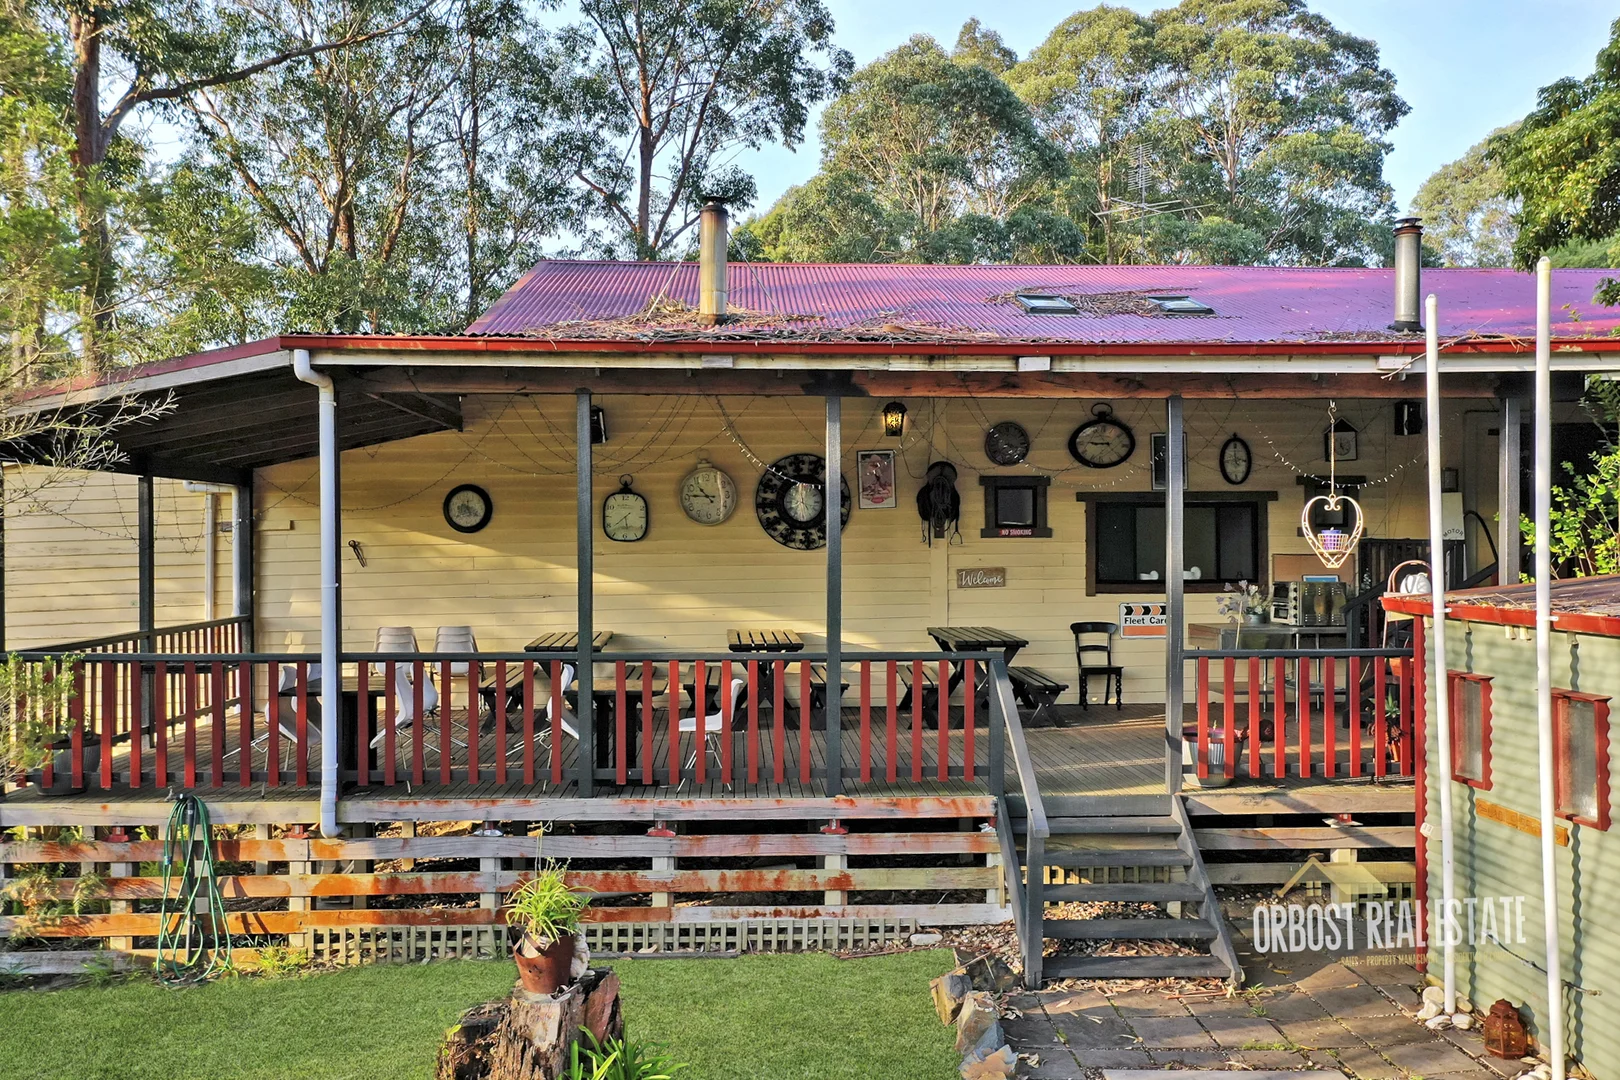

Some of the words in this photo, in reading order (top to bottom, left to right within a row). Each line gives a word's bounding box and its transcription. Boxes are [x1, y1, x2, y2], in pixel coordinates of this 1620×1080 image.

[702, 473, 710, 481] 12
[725, 490, 730, 499] 3
[1443, 529, 1464, 537] MOTOR
[959, 570, 1004, 586] Welcome
[1124, 616, 1145, 625] Fleet
